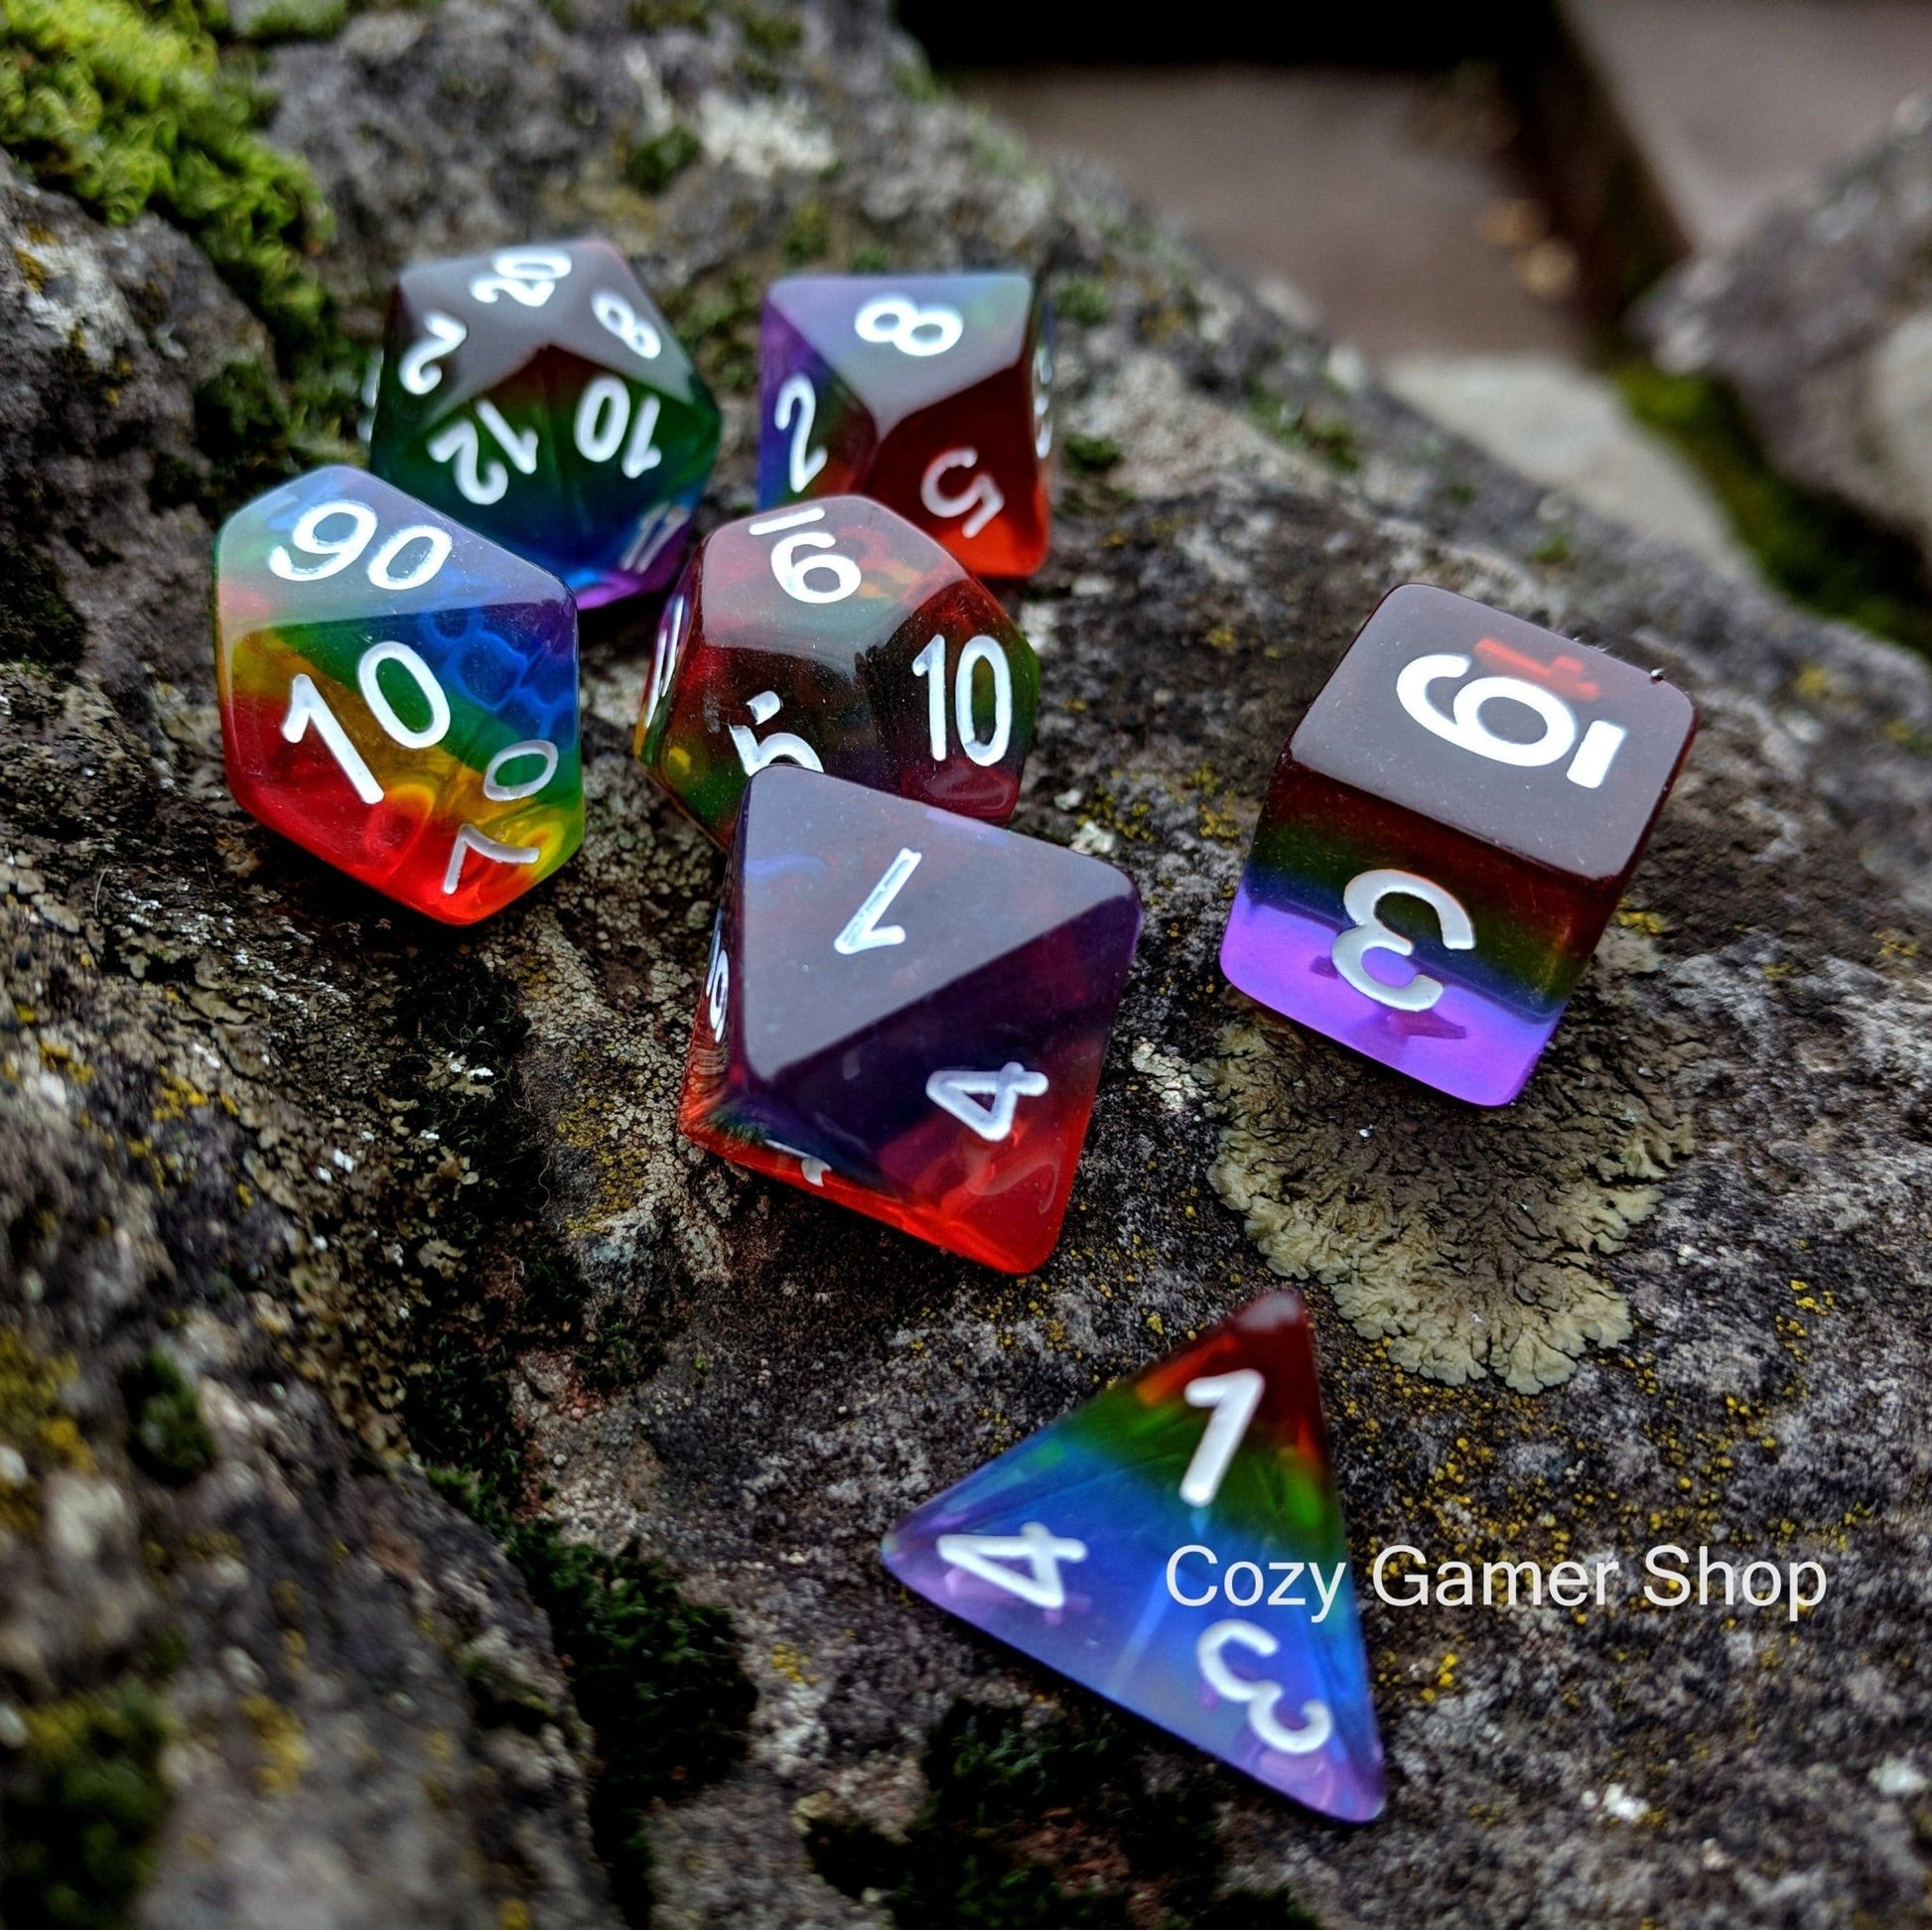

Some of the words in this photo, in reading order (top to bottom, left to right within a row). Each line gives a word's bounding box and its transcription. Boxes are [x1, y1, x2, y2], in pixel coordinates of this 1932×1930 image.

[470, 246, 573, 308] 20
[590, 294, 662, 360] 8
[854, 296, 964, 357] 8
[399, 311, 468, 395] 2
[426, 400, 539, 506] 12
[573, 373, 662, 480] 10
[774, 373, 828, 493] 2
[267, 499, 453, 591] 90
[920, 448, 1005, 538] 5
[281, 640, 451, 805] 10
[912, 633, 1013, 767] 10
[1396, 653, 1578, 767] 6
[442, 739, 559, 895] 70
[1331, 869, 1476, 1013] 3
[925, 1061, 1049, 1142] 4
[1179, 1369, 1266, 1507] 1
[937, 1521, 1087, 1608] 4
[1197, 1618, 1332, 1755] 3
